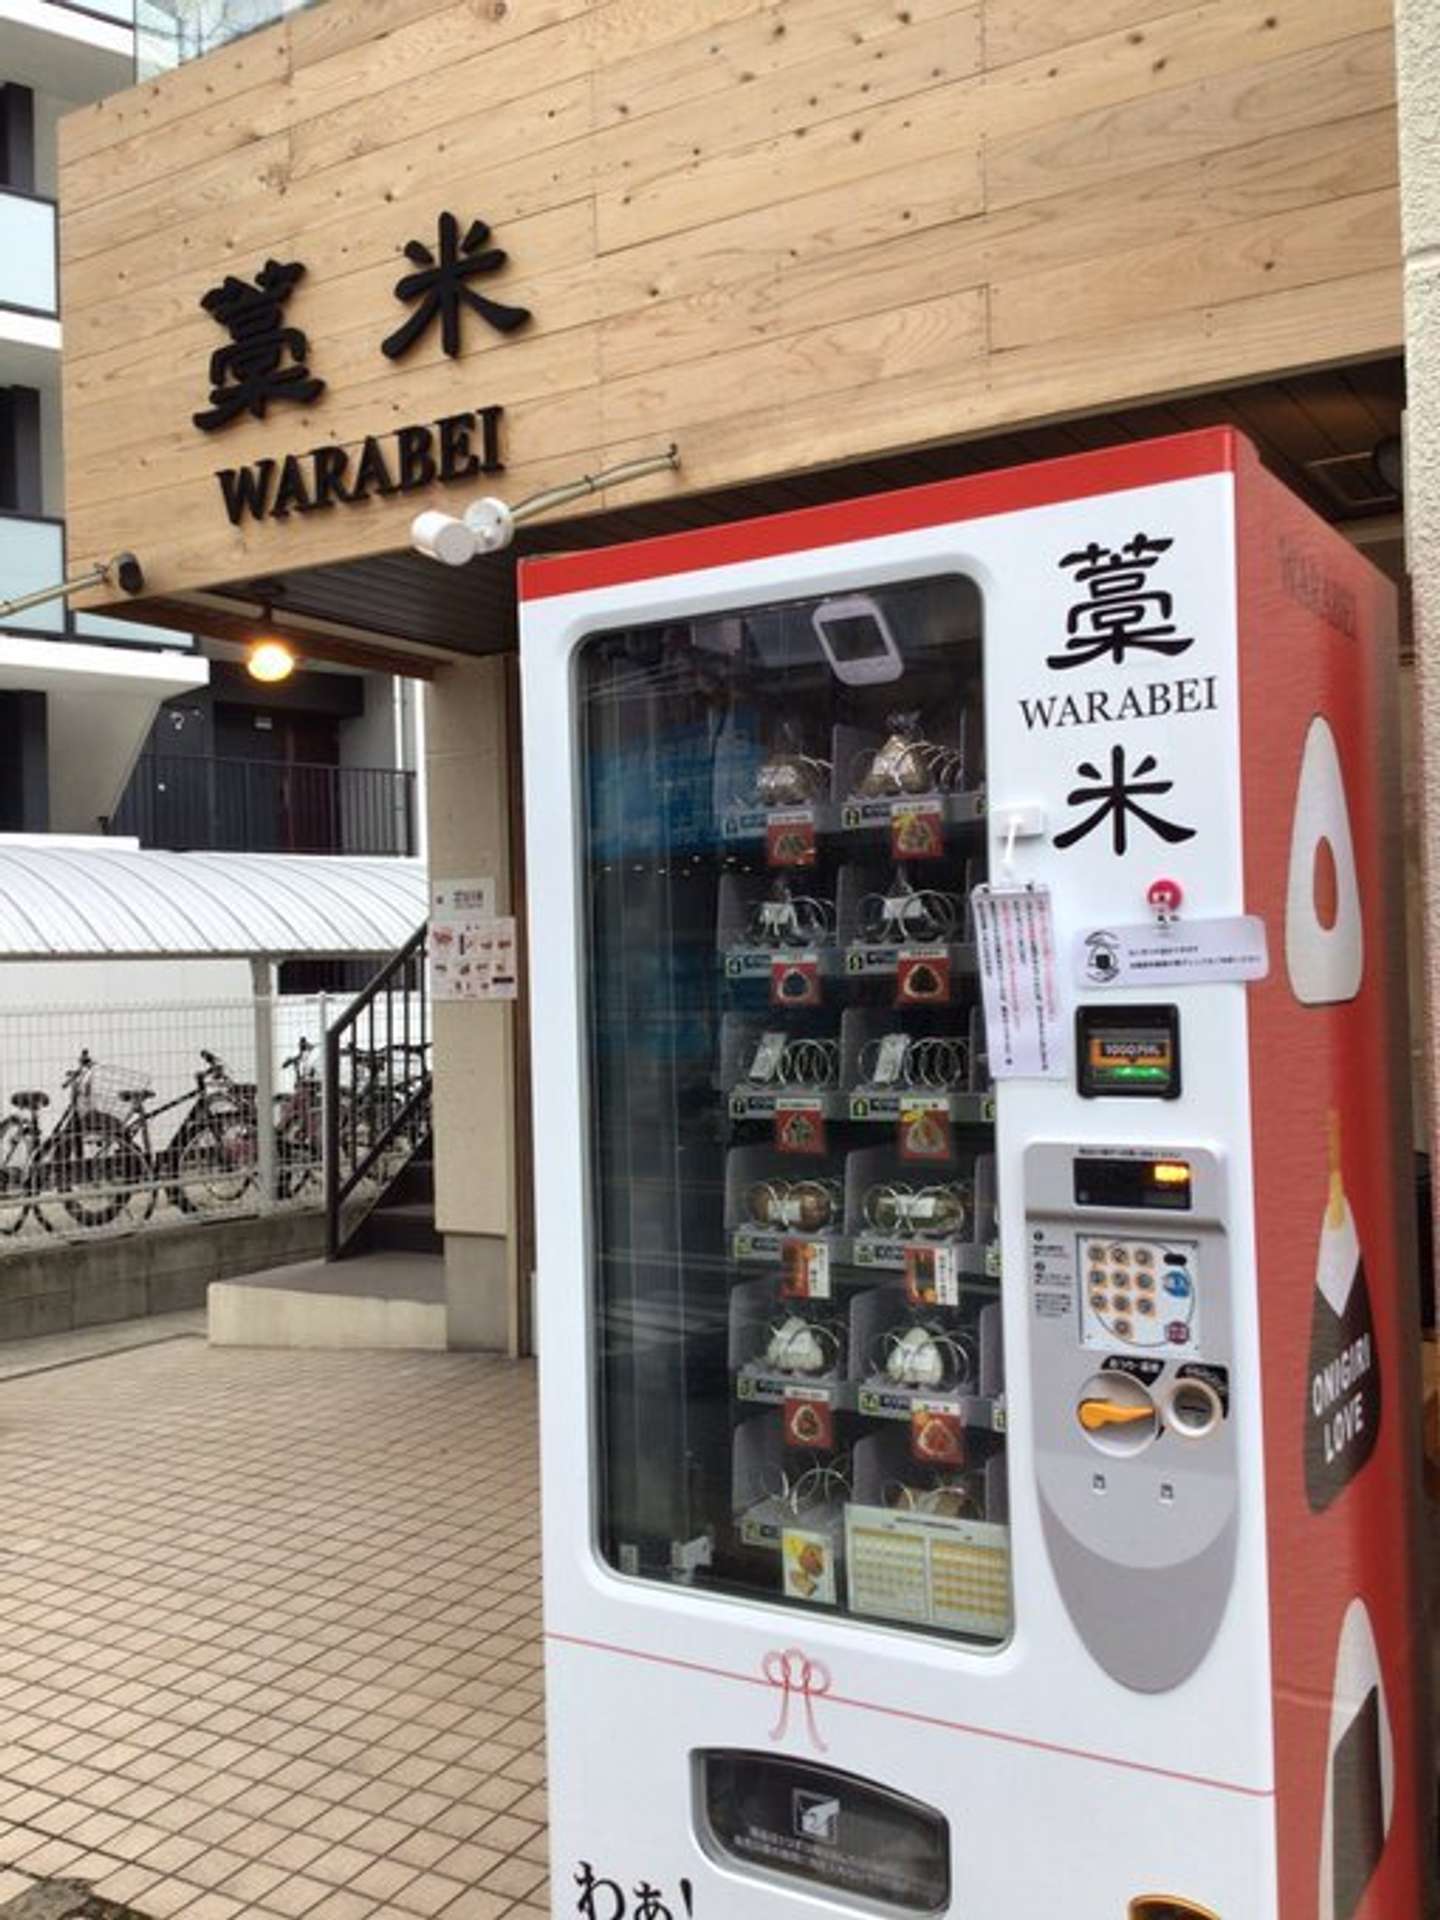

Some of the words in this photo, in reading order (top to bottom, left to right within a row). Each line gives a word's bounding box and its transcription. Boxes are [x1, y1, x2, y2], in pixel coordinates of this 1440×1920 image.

[192, 211, 532, 432] 藁米
[216, 406, 505, 526] WARABEI
[1045, 533, 1195, 669] 藁
[1019, 676, 1218, 730] WARABEI
[1053, 744, 1197, 856] 米
[1313, 1333, 1370, 1415] ONIGIRI
[1324, 1392, 1364, 1463] LOVE
